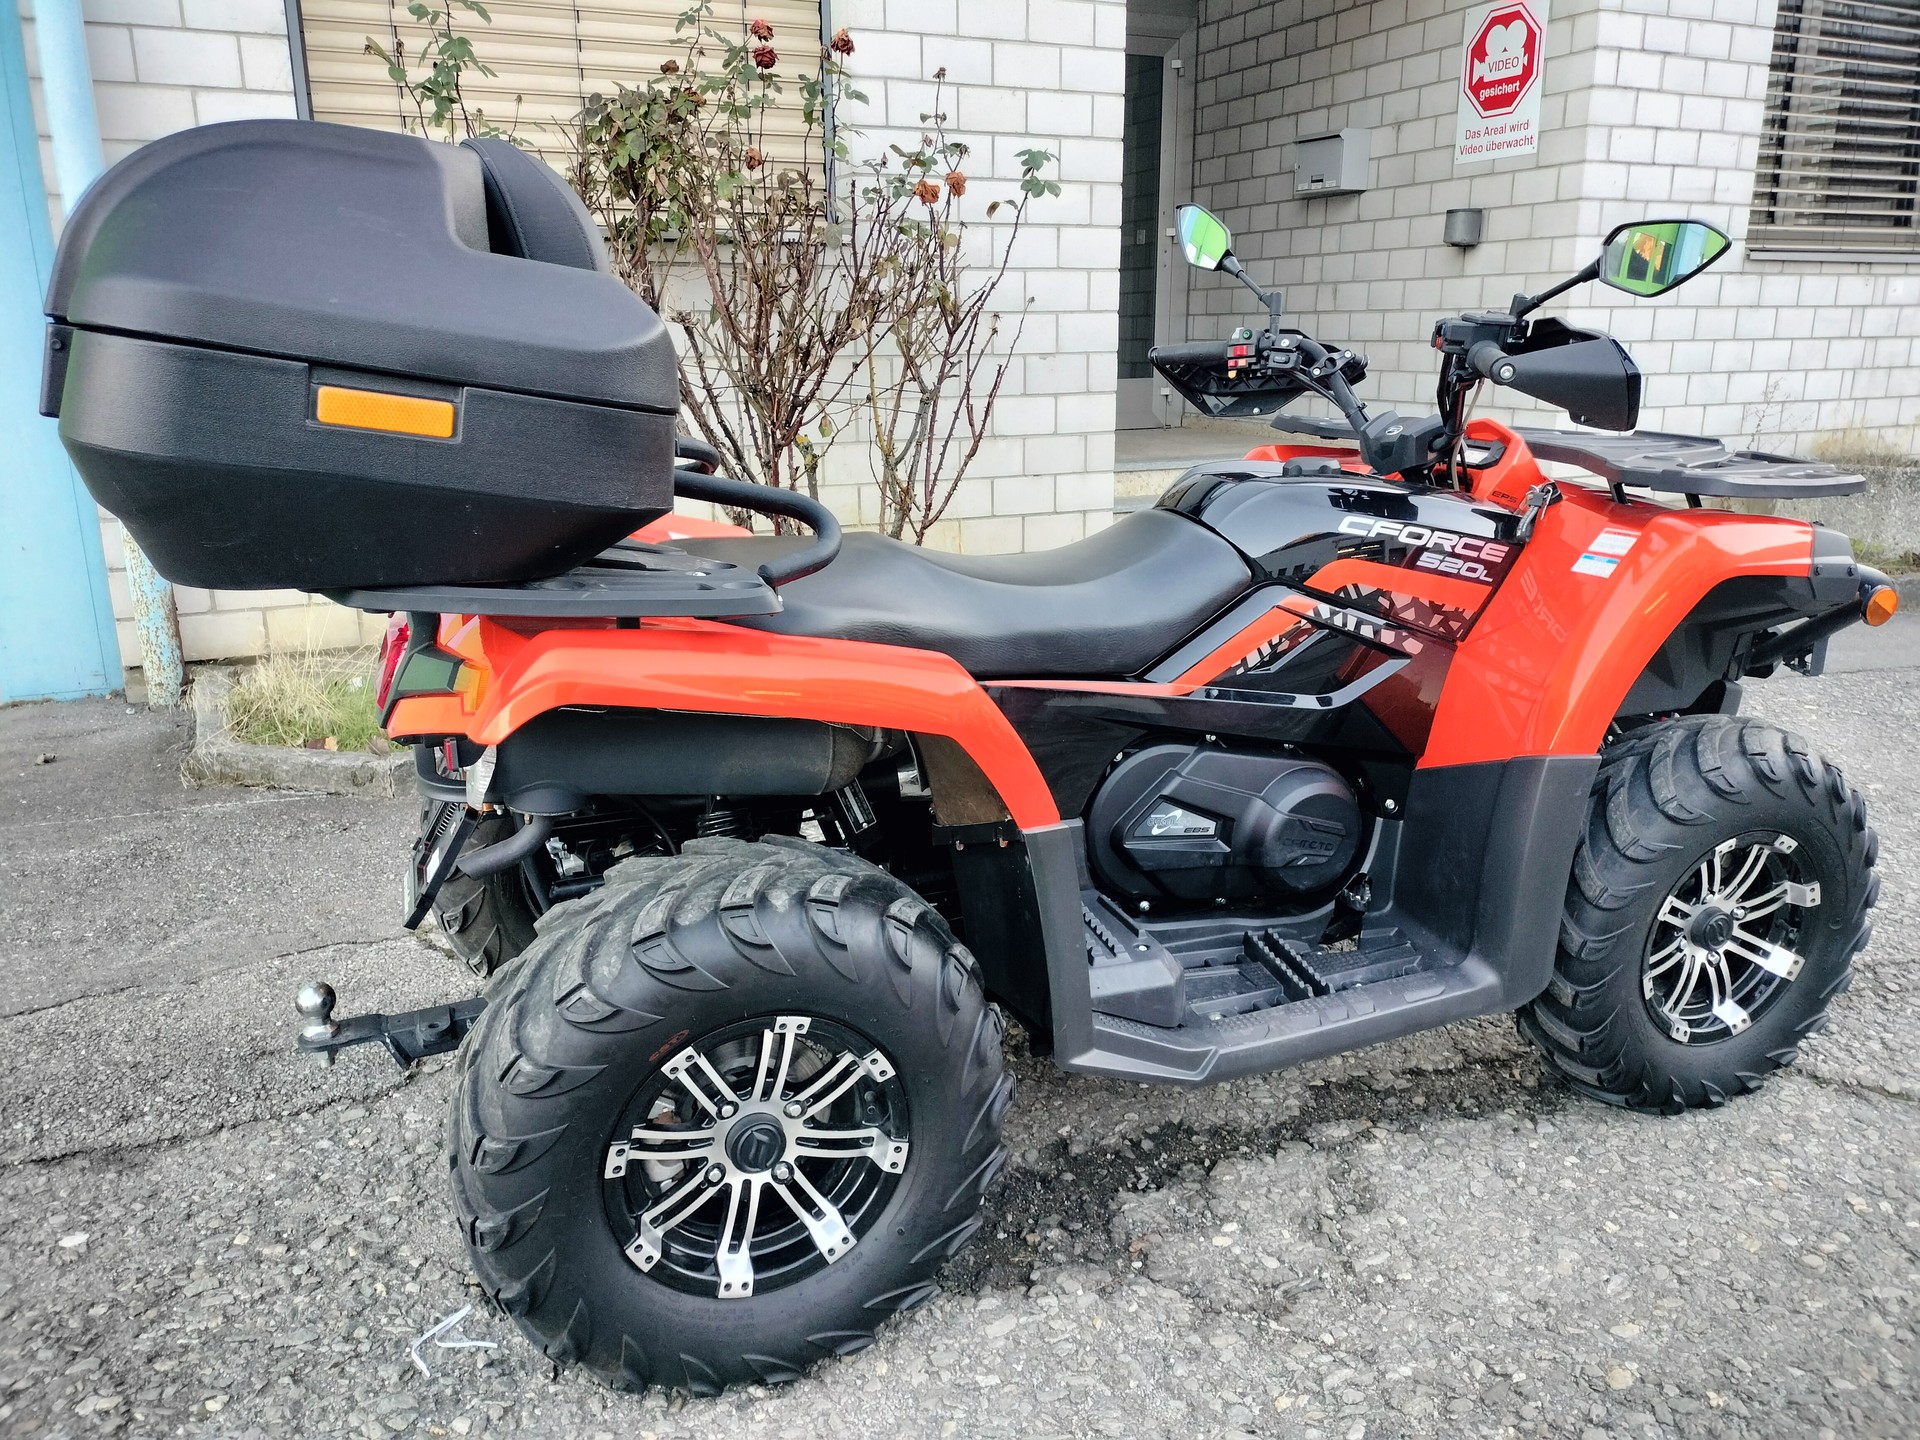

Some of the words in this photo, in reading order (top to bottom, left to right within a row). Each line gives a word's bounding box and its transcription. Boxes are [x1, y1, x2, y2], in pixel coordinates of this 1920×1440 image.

[1487, 56, 1520, 74] VIDEO
[1479, 80, 1521, 101] gesichert
[1465, 128, 1482, 141] Das
[1483, 123, 1507, 138] Areal
[1509, 119, 1530, 133] wird
[1459, 142, 1484, 156] Video
[1485, 134, 1534, 152] überwacht
[1491, 490, 1519, 504] EPS
[1337, 515, 1510, 563] CFORCE
[1183, 826, 1211, 834] EBS
